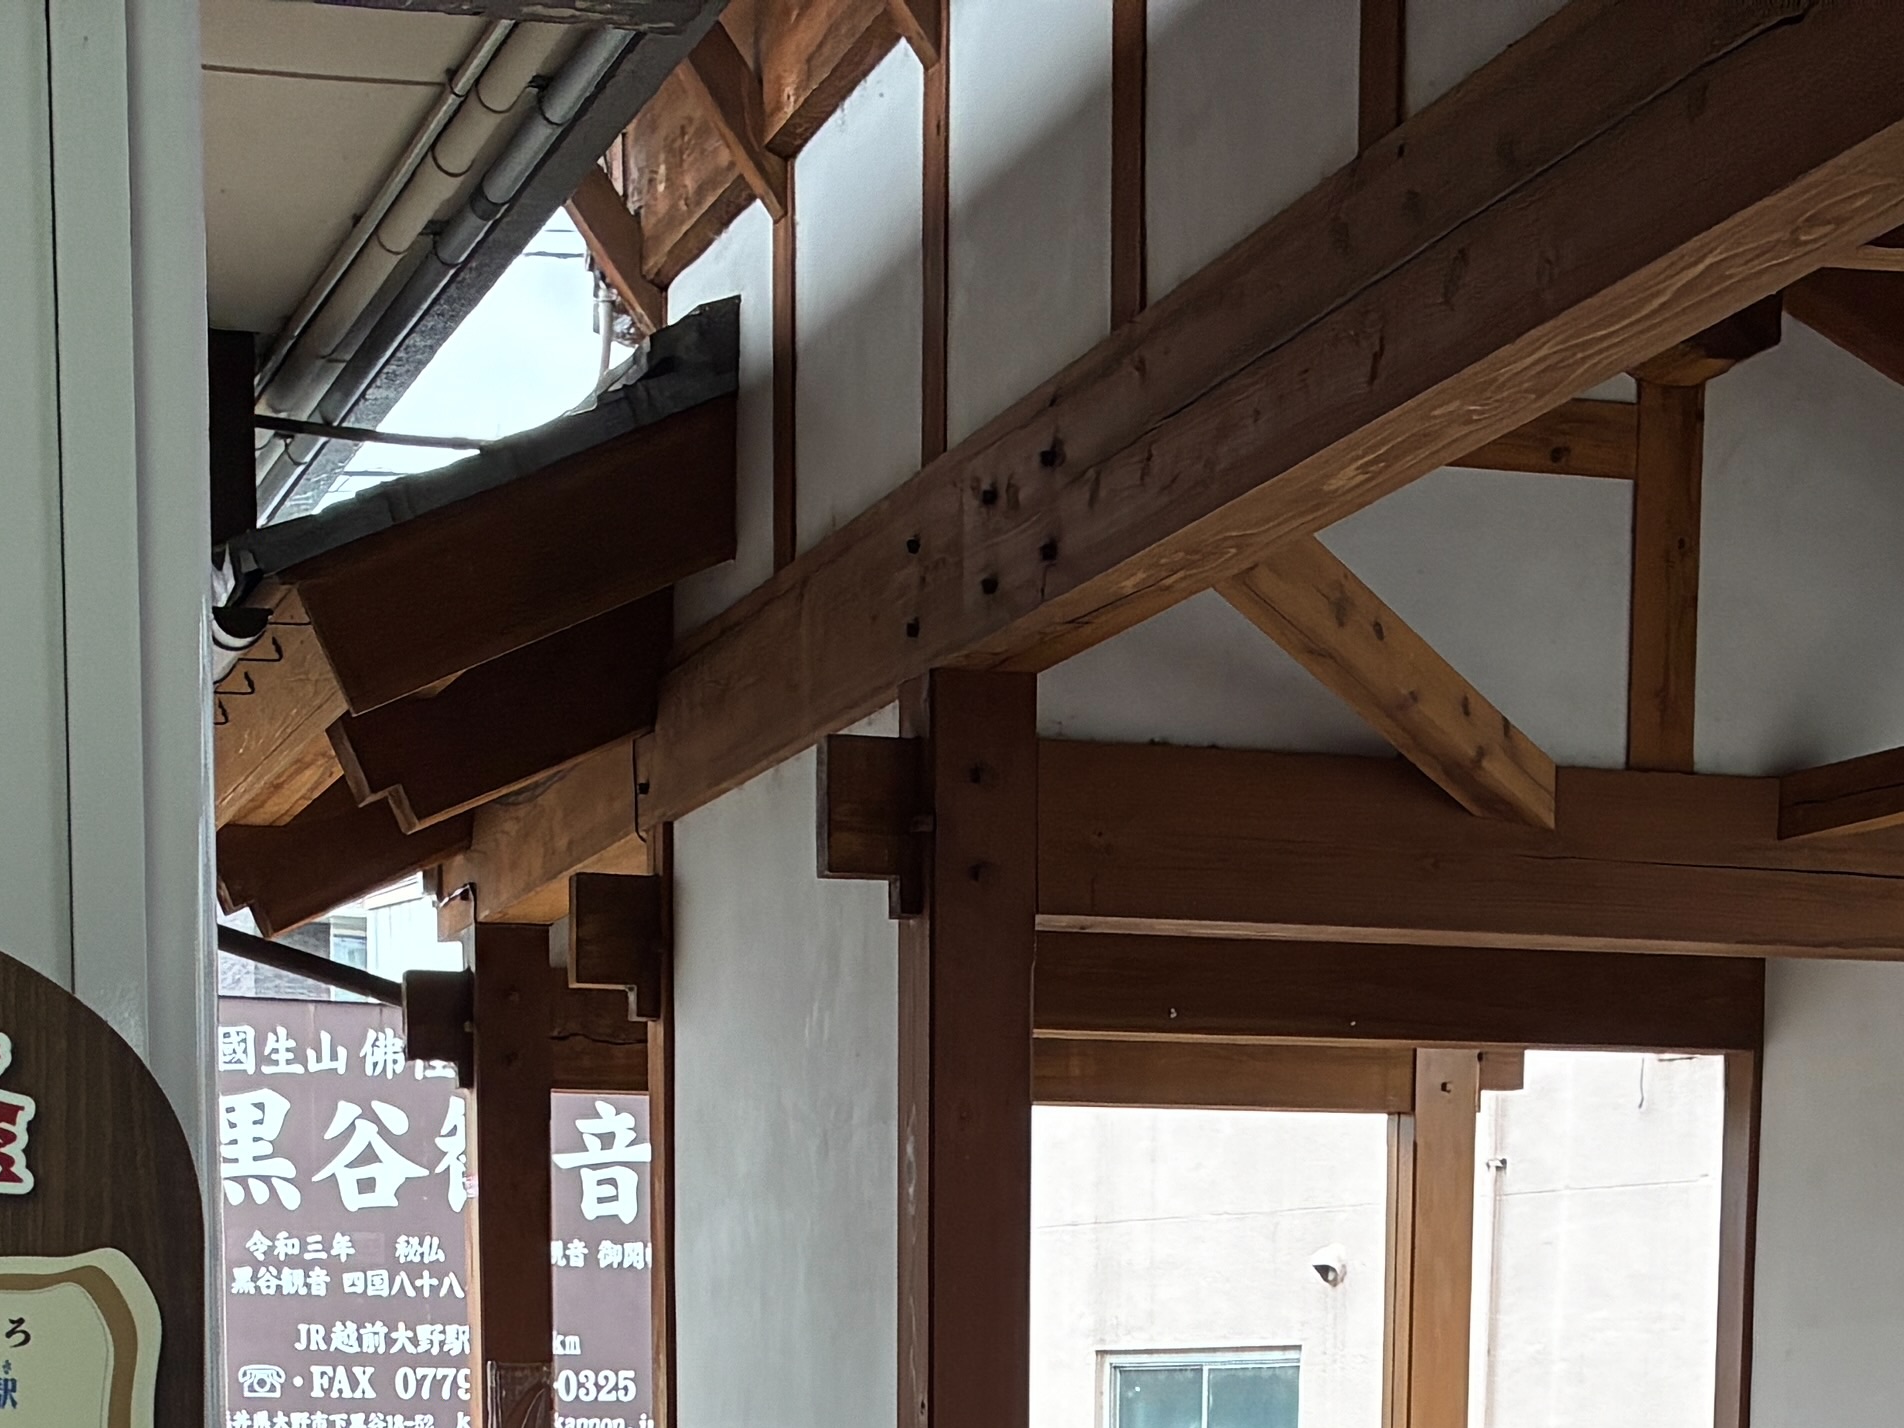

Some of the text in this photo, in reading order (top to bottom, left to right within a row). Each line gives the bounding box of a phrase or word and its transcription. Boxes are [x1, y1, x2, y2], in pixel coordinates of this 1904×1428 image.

[246, 1229, 356, 1262] 令和三年
[598, 1240, 654, 1270] 御開
[231, 1265, 331, 1297] 黒谷観音
